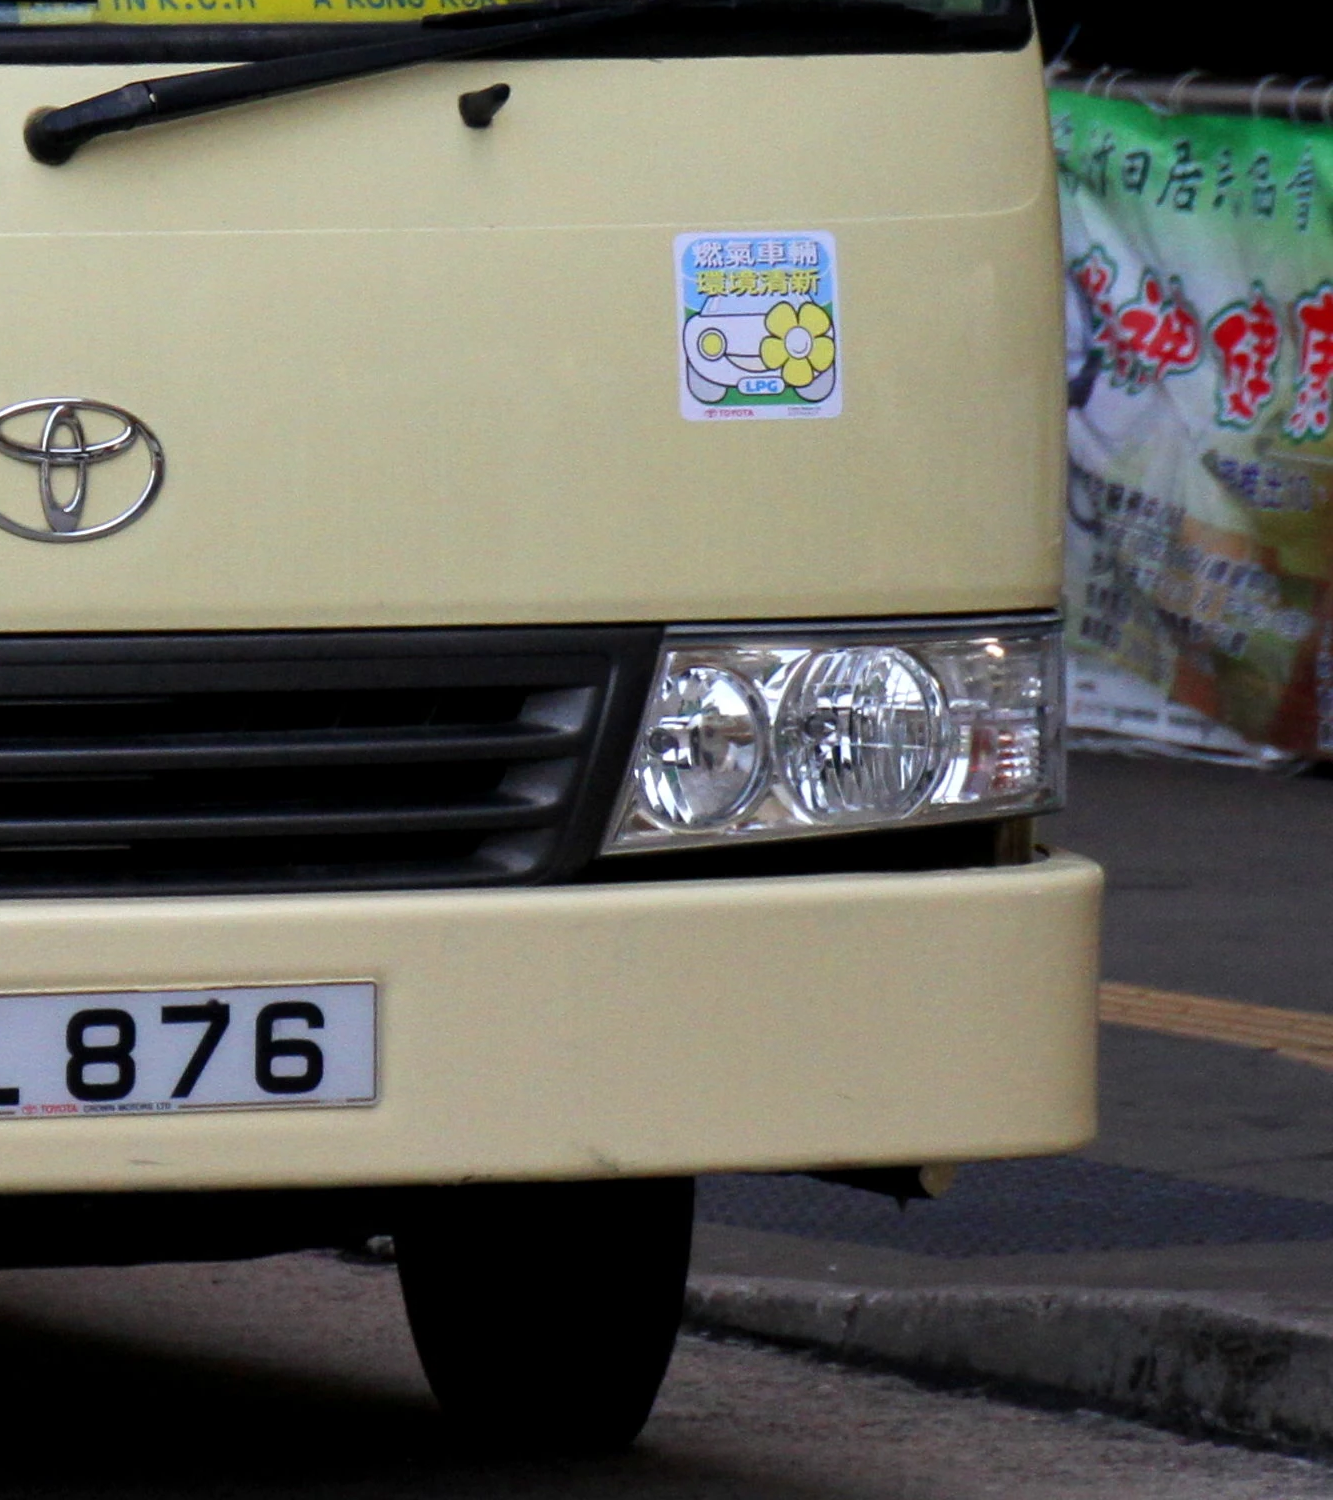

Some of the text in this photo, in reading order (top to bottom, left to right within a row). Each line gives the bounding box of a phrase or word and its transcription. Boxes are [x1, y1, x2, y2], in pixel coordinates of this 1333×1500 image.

[745, 380, 778, 392] LPG
[719, 408, 755, 417] TOYOTA
[65, 1001, 325, 1102] 876
[41, 1104, 78, 1114] TOYOTA
